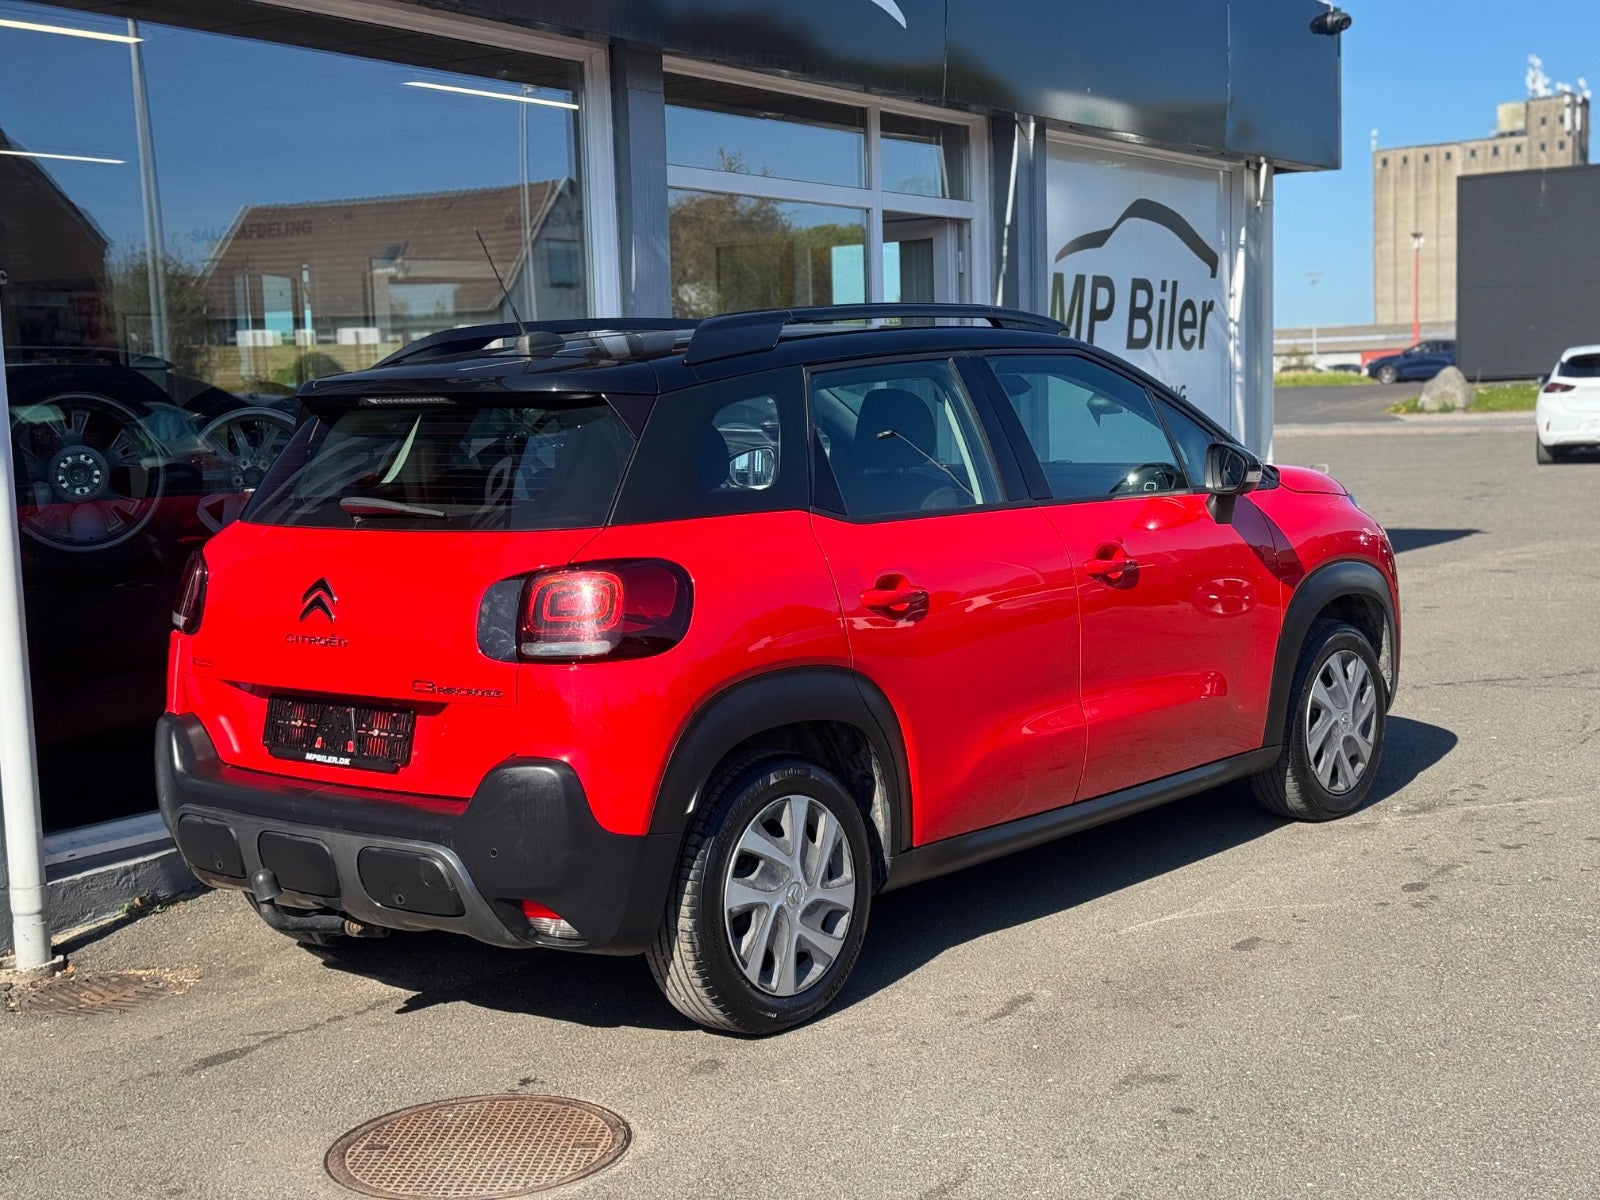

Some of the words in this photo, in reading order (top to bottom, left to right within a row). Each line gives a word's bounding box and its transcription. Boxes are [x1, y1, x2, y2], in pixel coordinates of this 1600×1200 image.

[1049, 272, 1116, 346] MP
[1126, 277, 1215, 351] Biler
[305, 752, 352, 766] MPBILER.DK
